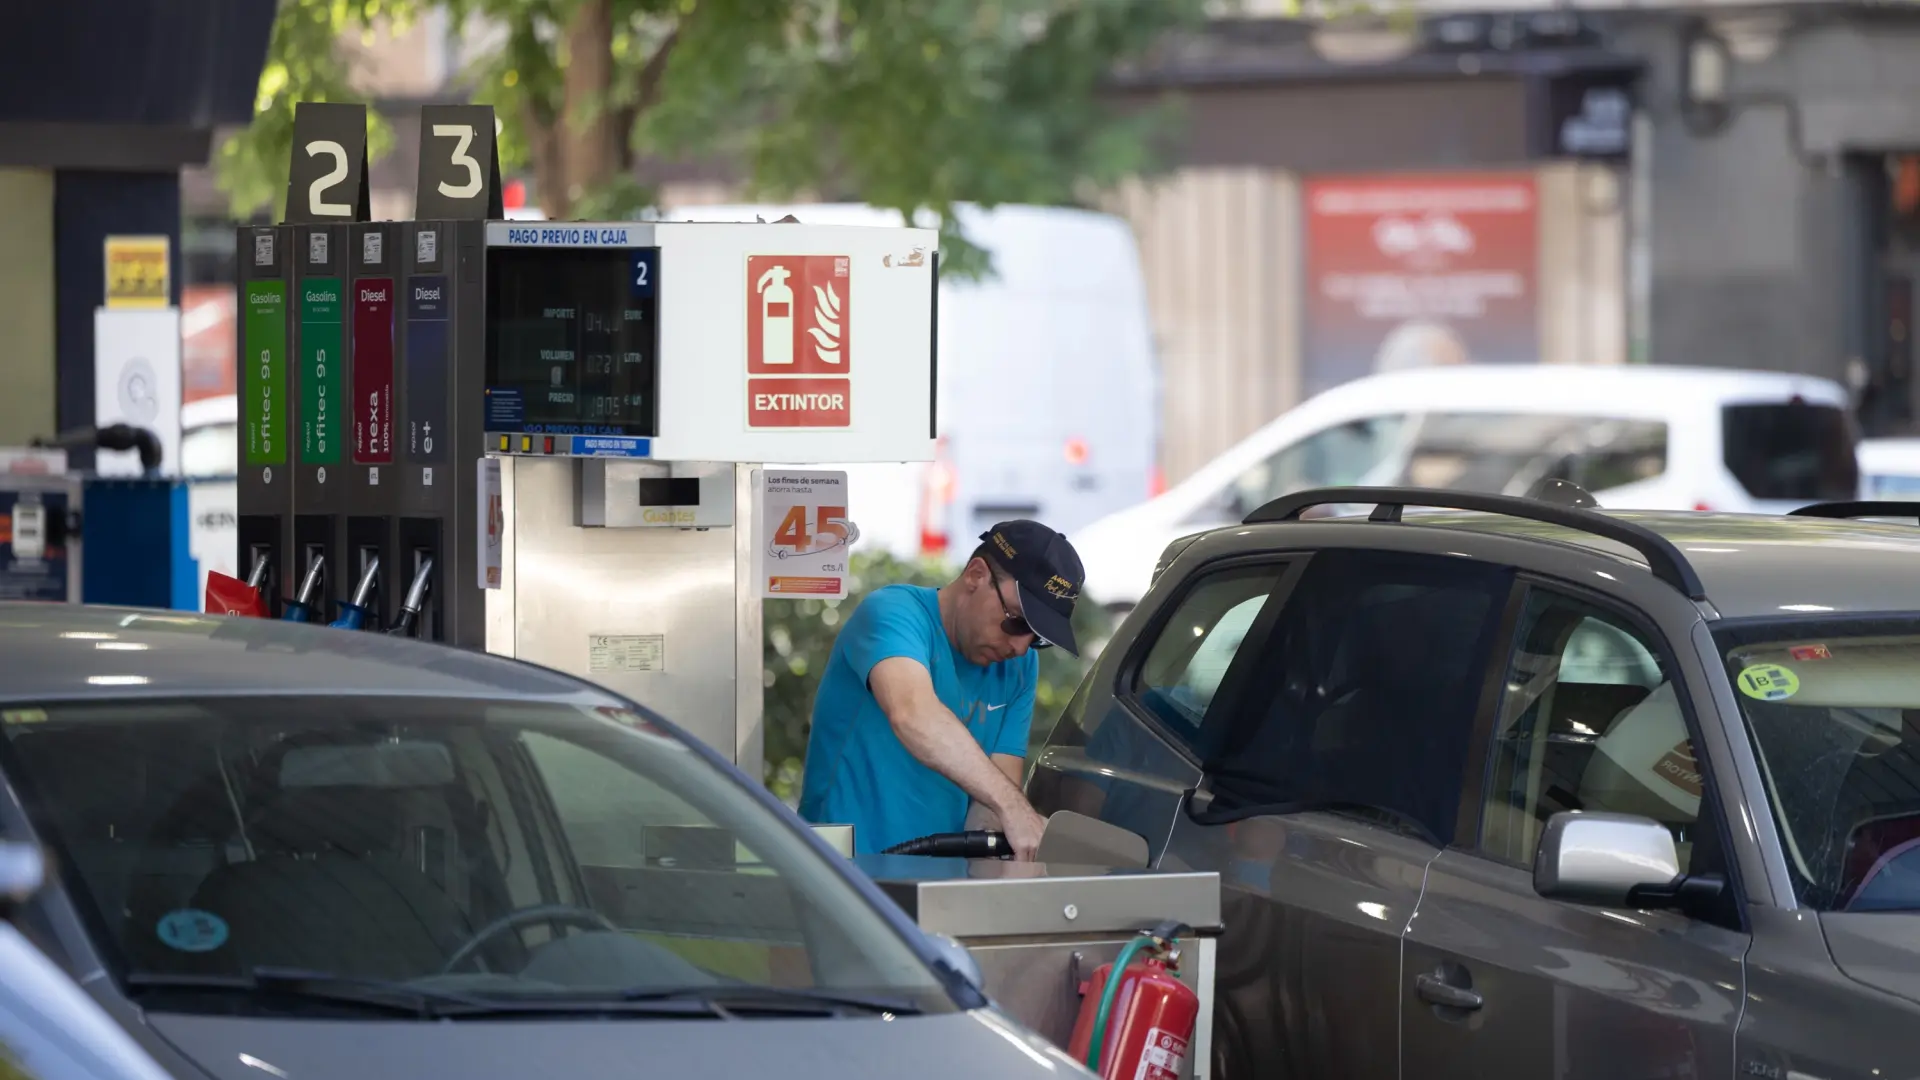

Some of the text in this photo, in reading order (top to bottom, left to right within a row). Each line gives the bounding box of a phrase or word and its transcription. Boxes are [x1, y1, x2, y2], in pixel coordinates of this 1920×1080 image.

[433, 124, 483, 198] 3
[305, 140, 351, 216] 2
[508, 229, 628, 244] PAGO PREVIO EN CAJA
[636, 261, 647, 285] 2
[250, 293, 281, 304] Gasolina
[306, 291, 336, 303] Gasolina
[361, 289, 386, 302] Diesel
[415, 287, 440, 300] Diesel
[261, 349, 271, 453] efitec 98
[316, 349, 326, 453] efitec 95
[548, 393, 574, 404] PRECIO
[755, 393, 844, 411] EXTINTOR
[370, 391, 378, 454] nexa
[423, 421, 433, 453] e+
[781, 476, 799, 484] fines
[800, 477, 809, 485] de
[643, 509, 696, 523] Guantes
[774, 505, 849, 554] 45
[1756, 676, 1769, 686] B
